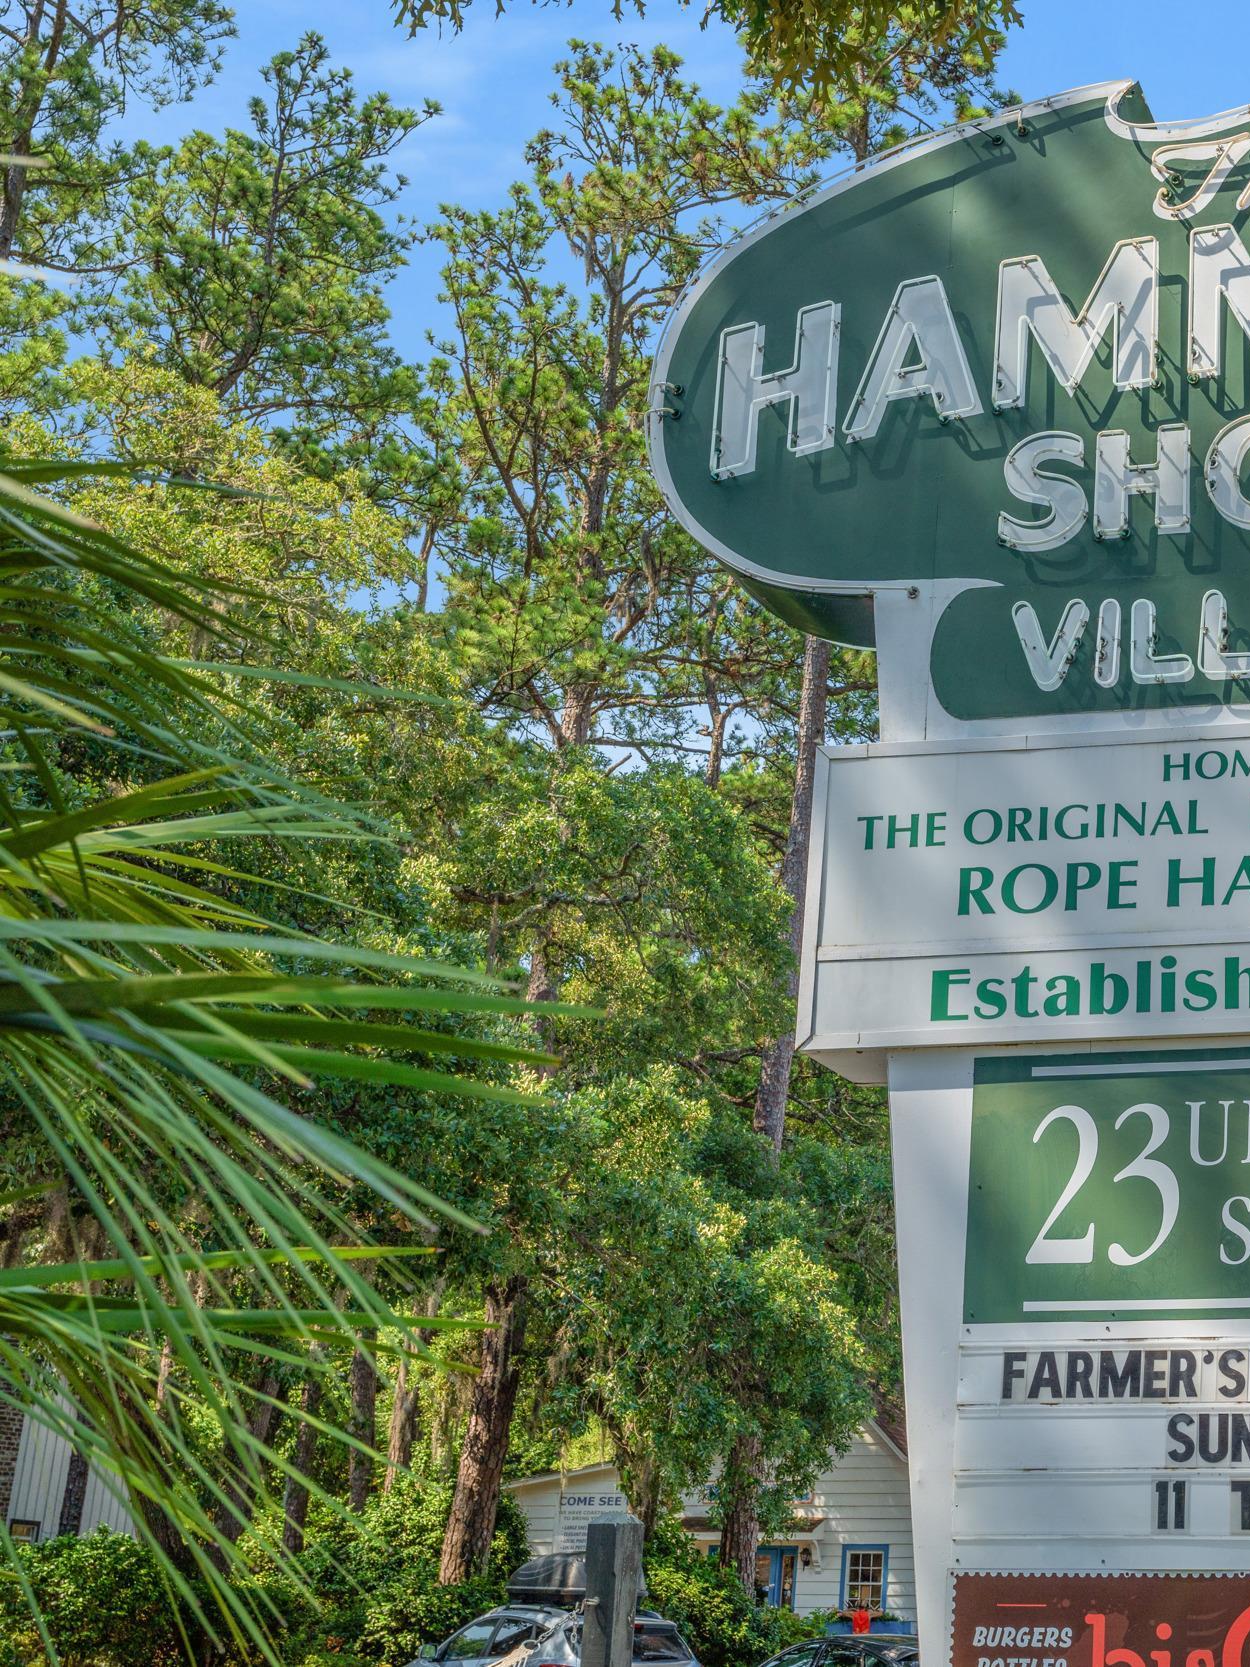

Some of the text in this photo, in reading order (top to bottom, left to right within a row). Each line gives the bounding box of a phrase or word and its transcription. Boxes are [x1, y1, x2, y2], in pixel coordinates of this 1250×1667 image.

[857, 811, 947, 850] THE
[963, 799, 1209, 845] ORIGINAL
[957, 860, 1138, 916] ROPE
[1025, 1103, 1180, 1267] 23
[1002, 1350, 1246, 1399] FARMER'S
[560, 1496, 596, 1506] COME
[598, 1496, 622, 1506] SEE
[1155, 1480, 1187, 1530] 11
[972, 1626, 1073, 1649] BURGERS
